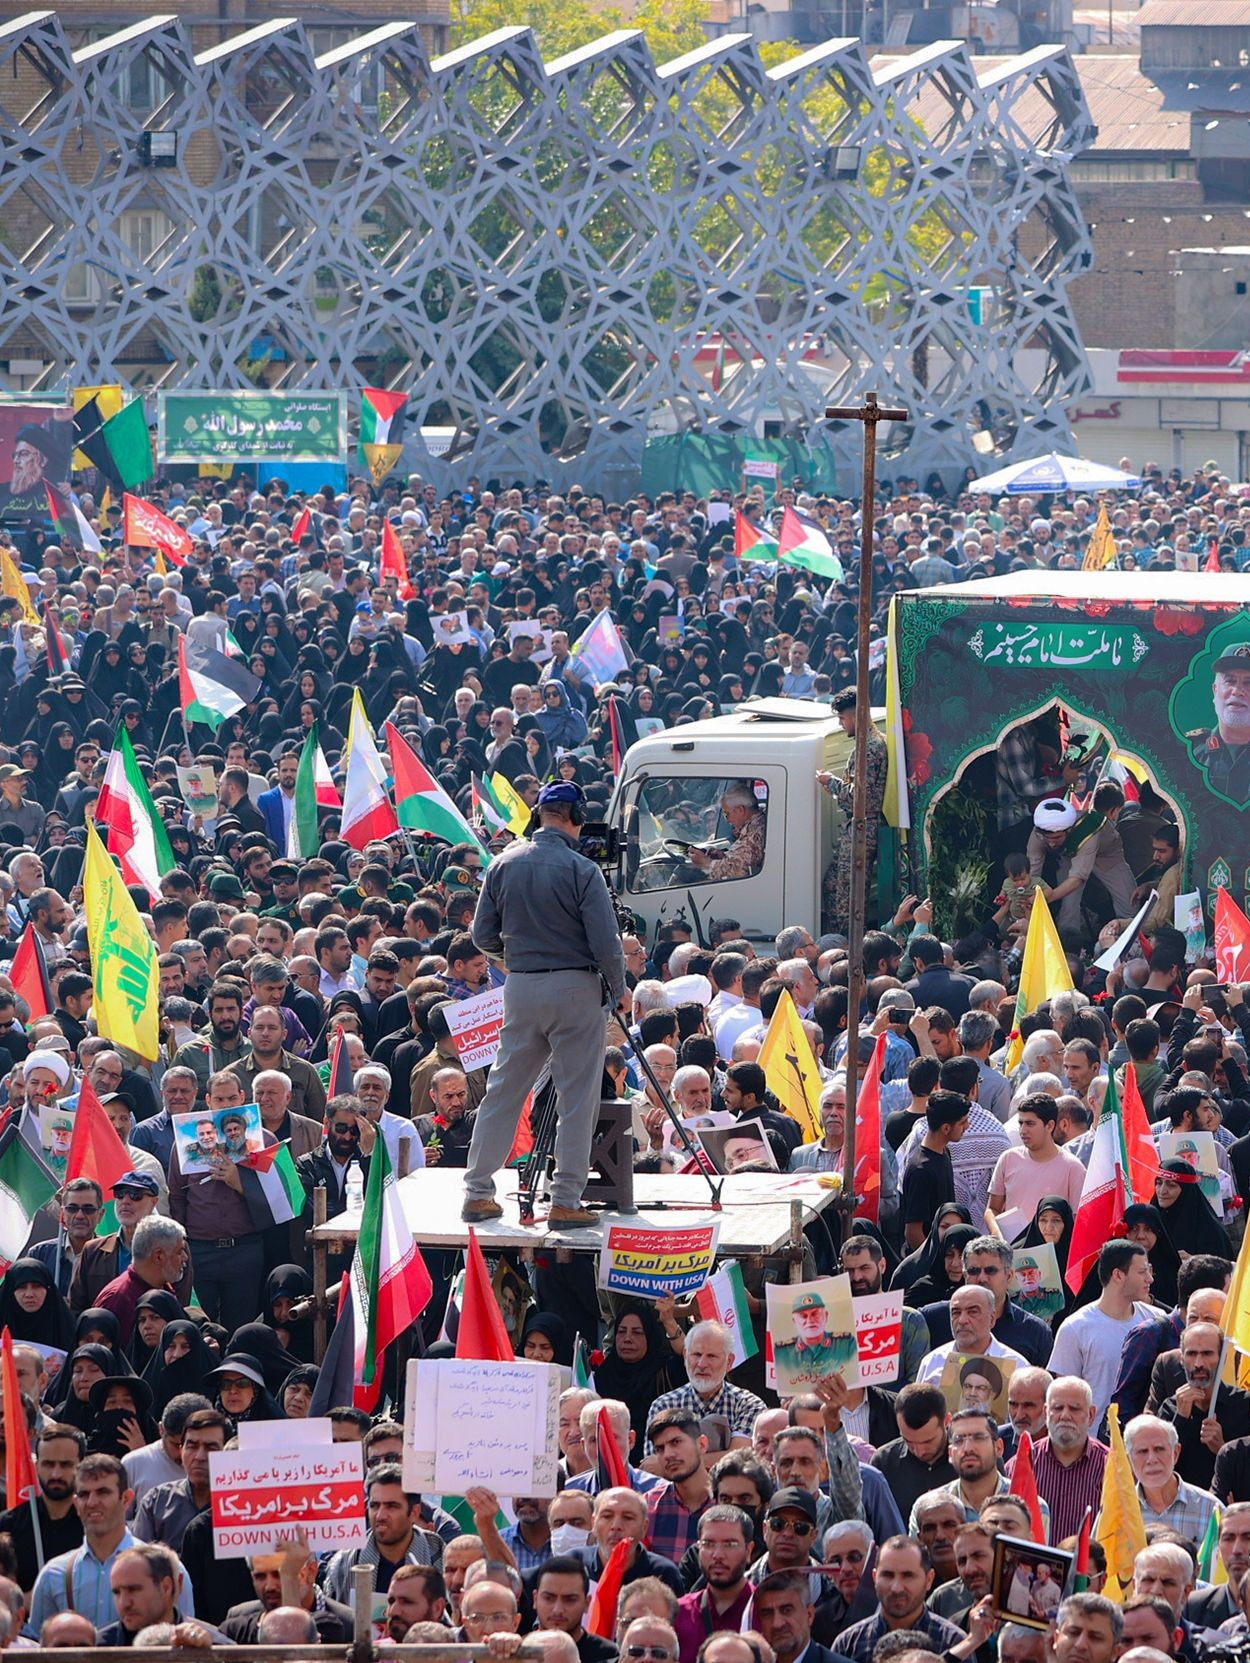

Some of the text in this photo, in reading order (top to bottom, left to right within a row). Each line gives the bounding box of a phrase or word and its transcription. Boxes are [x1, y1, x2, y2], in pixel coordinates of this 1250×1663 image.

[227, 415, 264, 436] رسول
[265, 418, 303, 432] محمد
[461, 1047, 492, 1064] DOWN
[614, 1254, 710, 1273] مرگ بر آمریکا
[610, 1273, 704, 1291] DOWN WITH USA
[861, 1360, 895, 1377] U.S.A
[282, 1468, 299, 1482] زیر
[301, 1466, 311, 1480] را
[313, 1461, 346, 1478] آمریکا
[349, 1462, 359, 1473] ما
[215, 1469, 250, 1486] گذاریم
[252, 1472, 270, 1483] می
[218, 1487, 359, 1521] مرگ بر امریکا
[218, 1523, 361, 1547] DOWN WIH U.S.A
